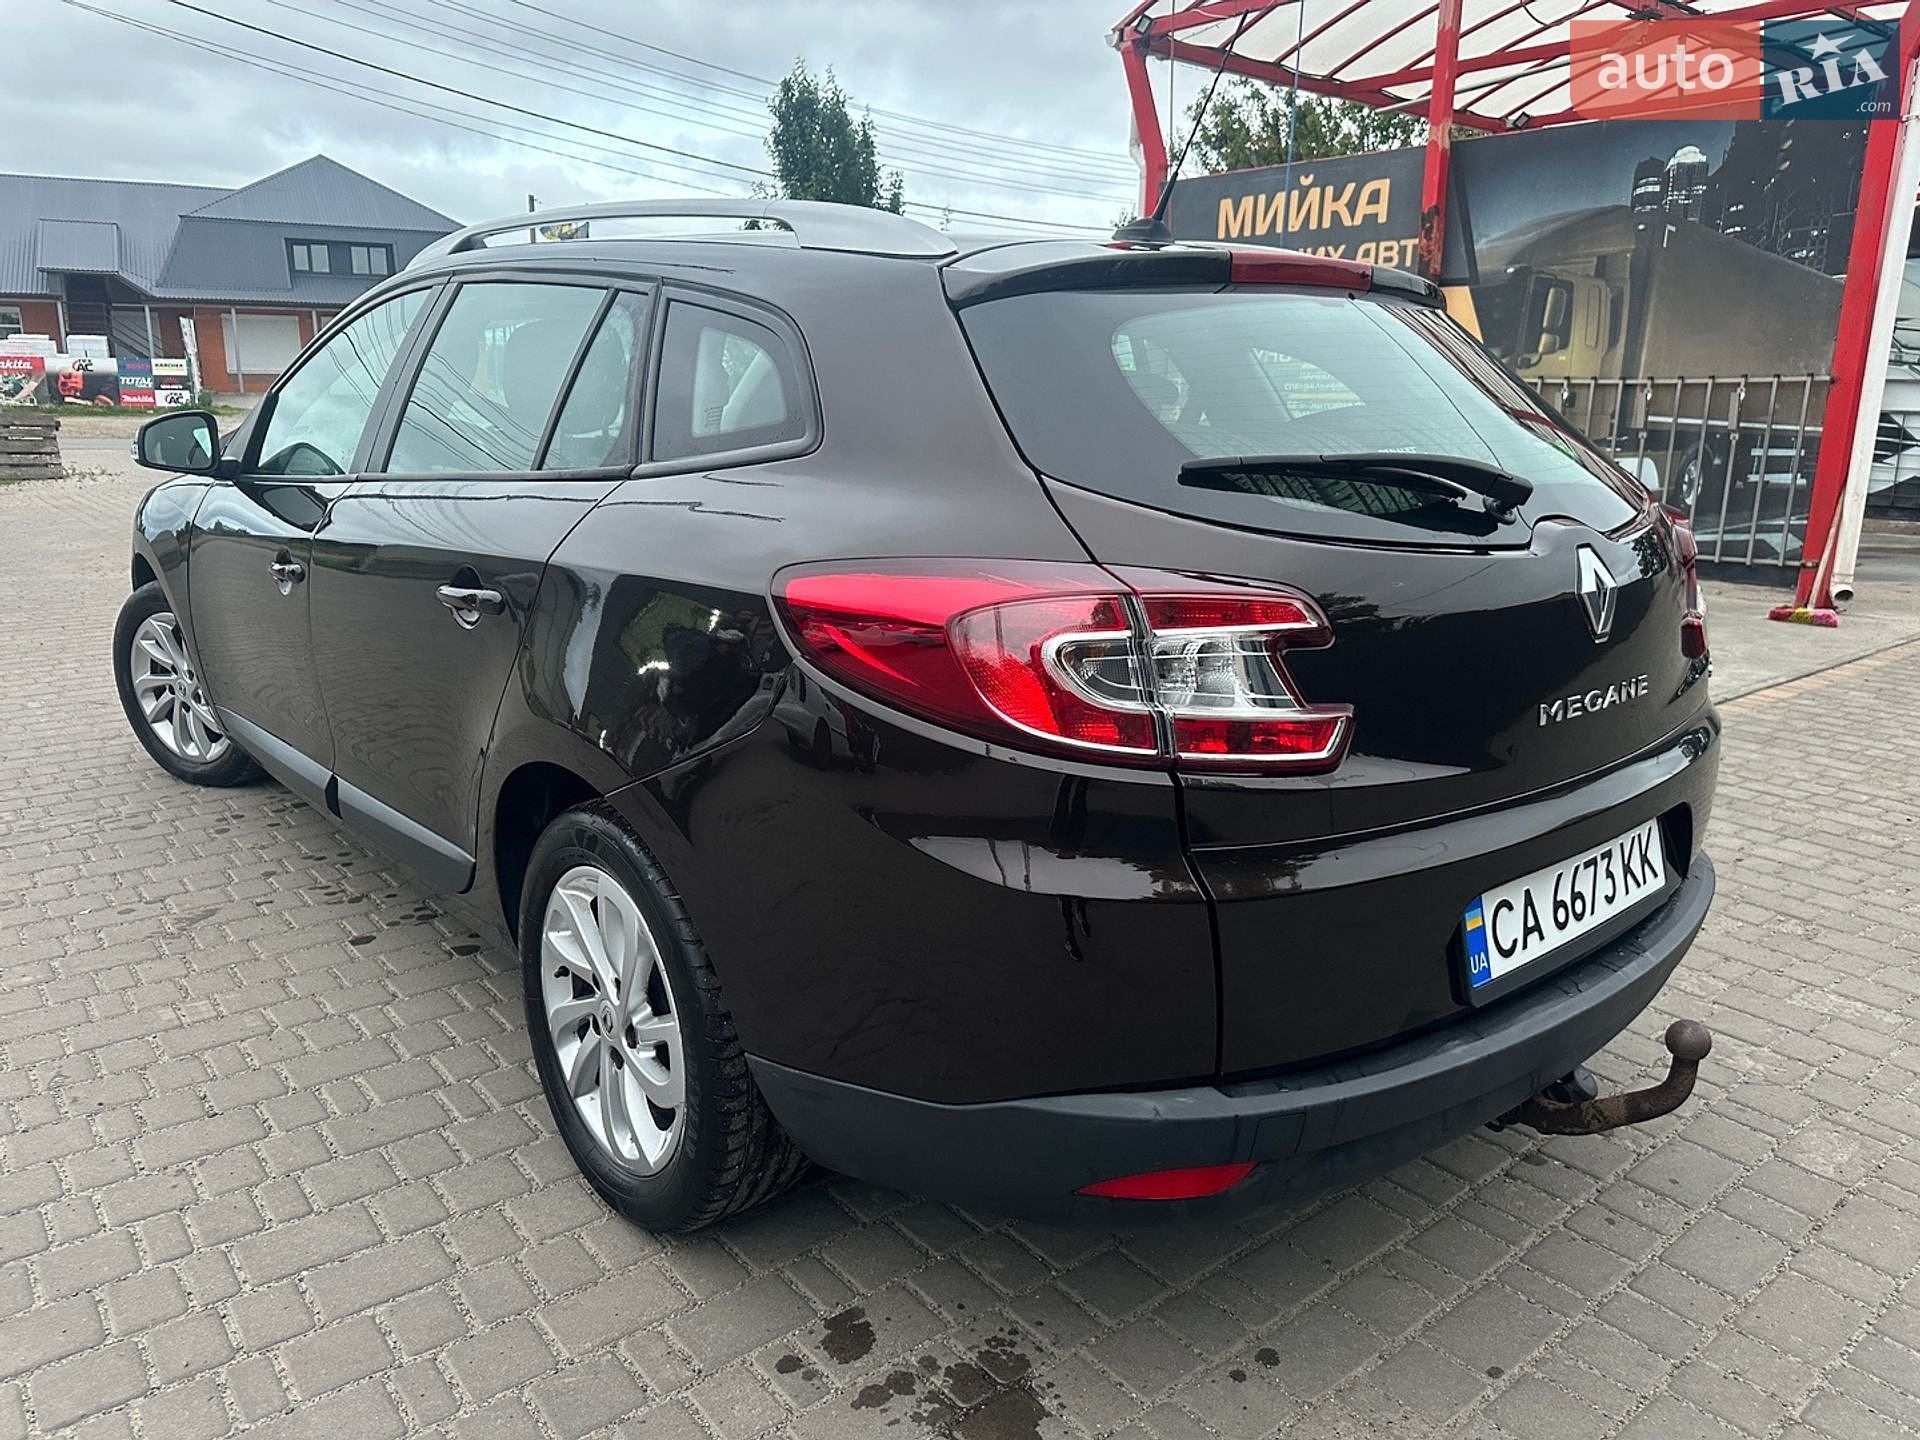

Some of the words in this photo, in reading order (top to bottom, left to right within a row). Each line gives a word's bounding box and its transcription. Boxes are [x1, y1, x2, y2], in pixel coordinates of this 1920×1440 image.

[1217, 174, 1391, 240] МИЙКА
[1537, 674, 1649, 728] MEGANE
[1492, 888, 1545, 958] CA
[1552, 848, 1617, 932] 6673
[1620, 825, 1660, 897] KK
[1470, 954, 1489, 975] UA
